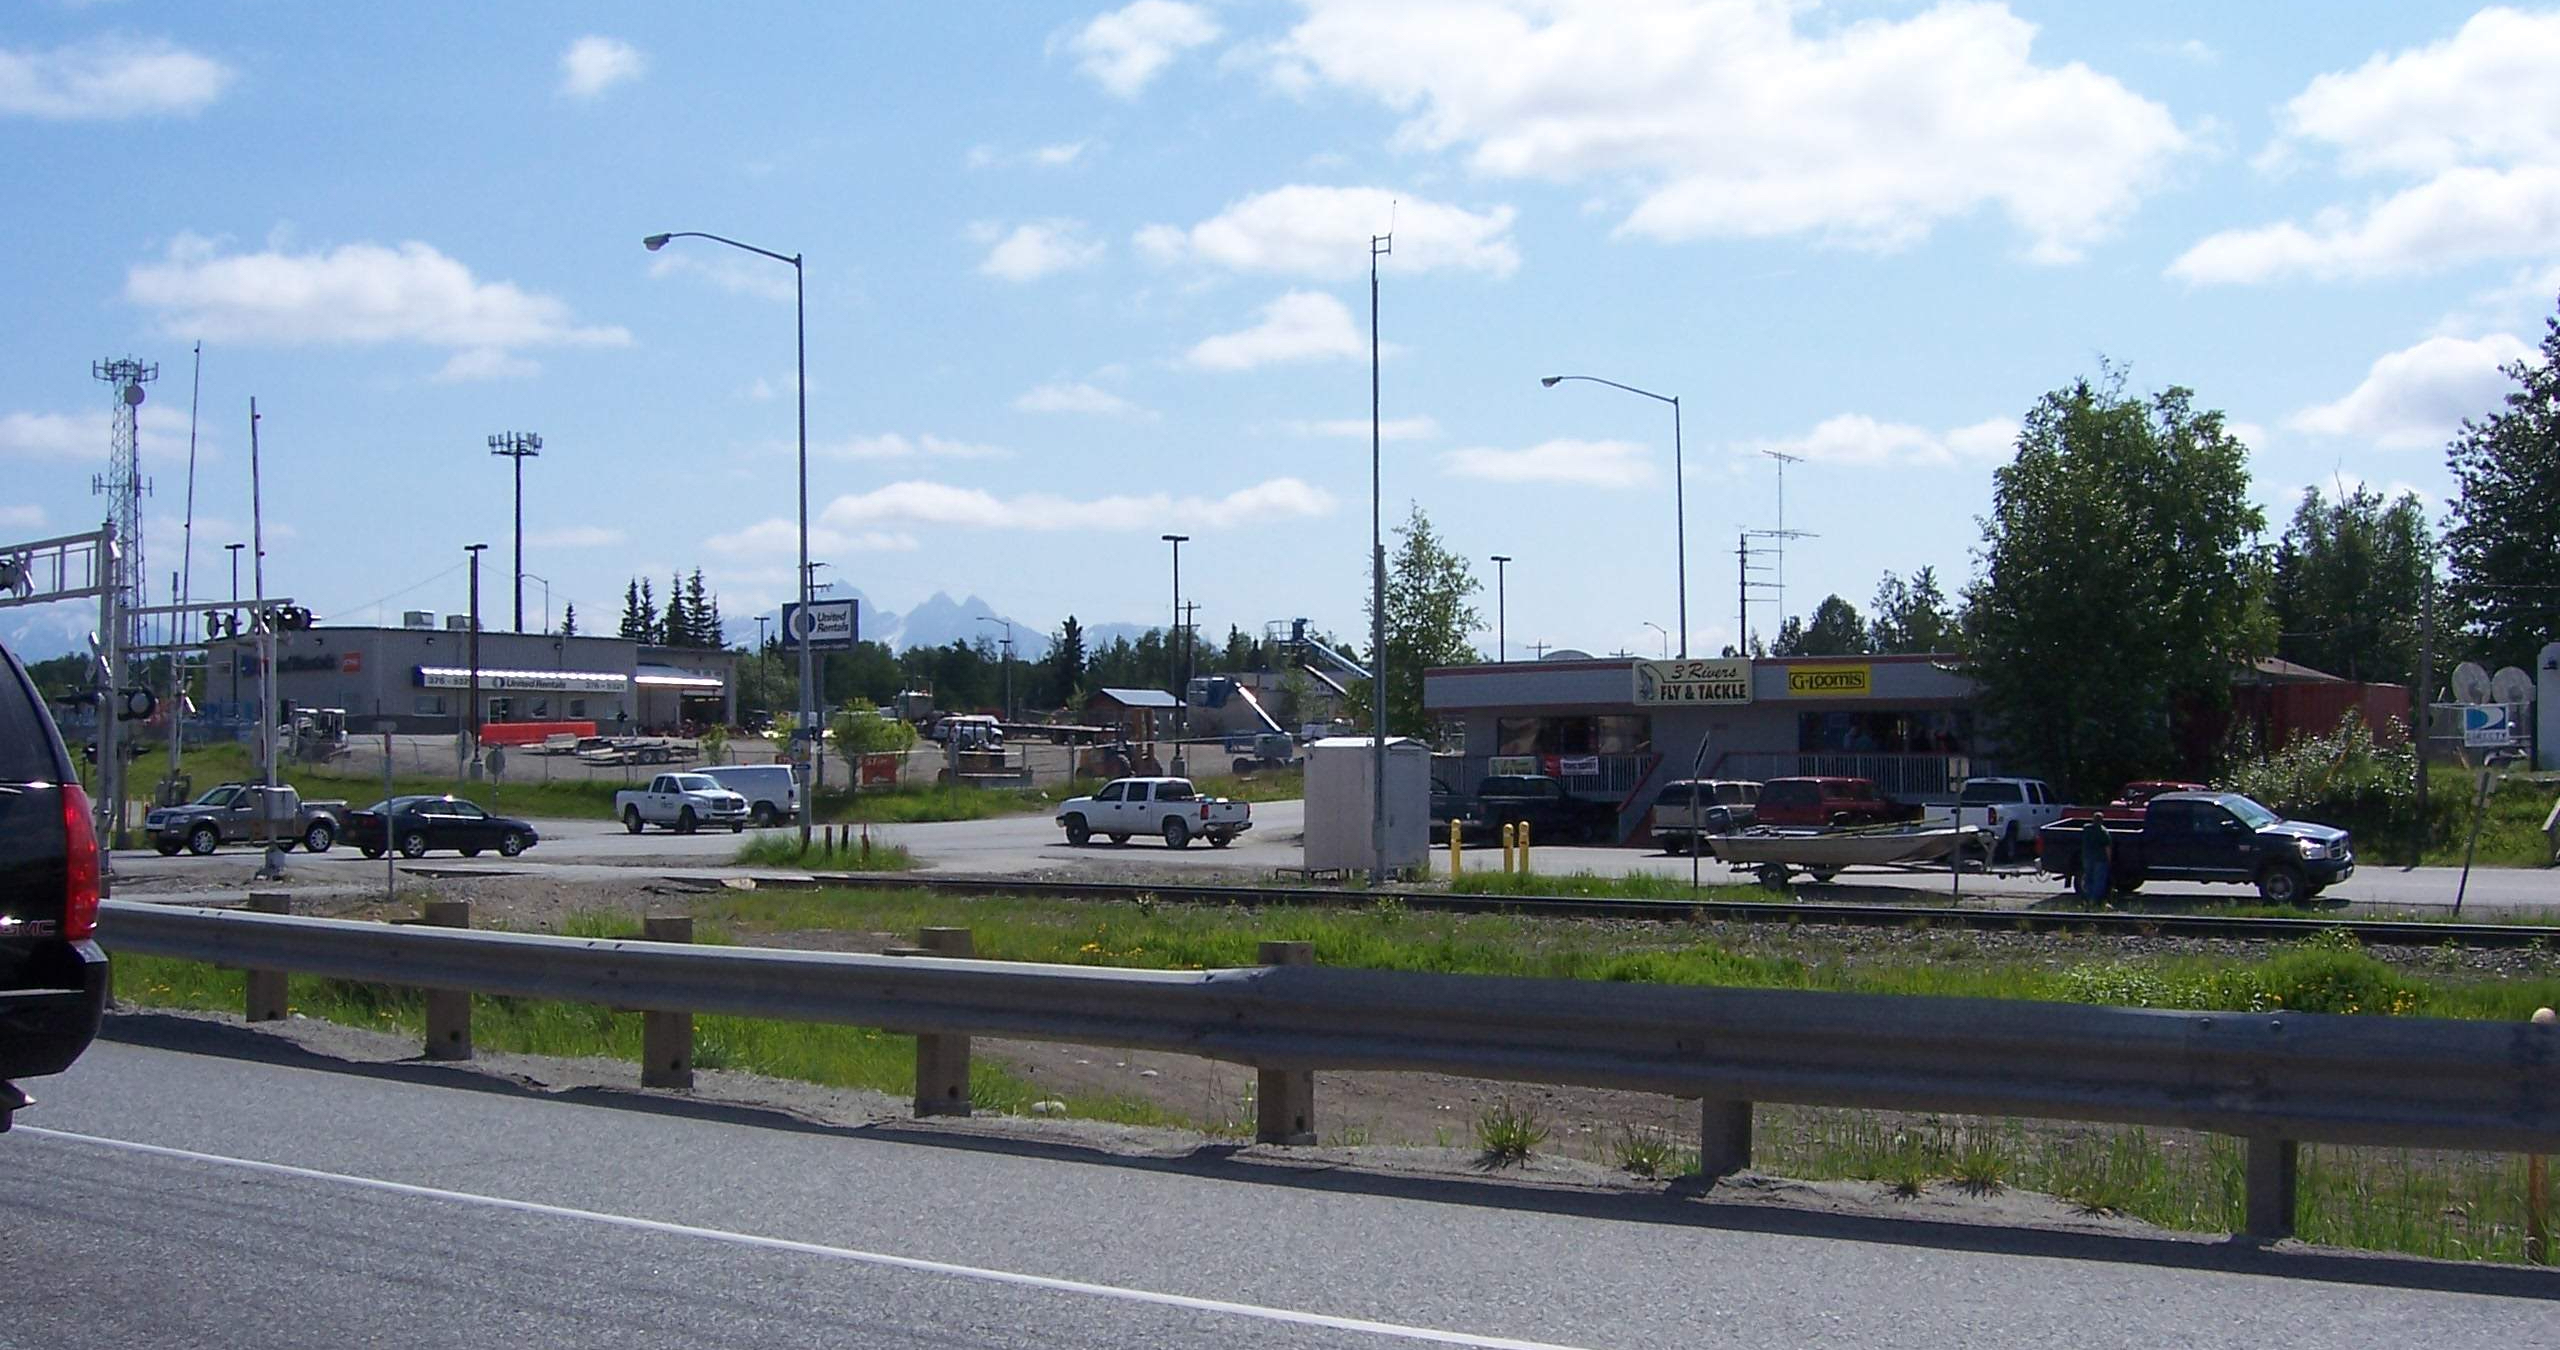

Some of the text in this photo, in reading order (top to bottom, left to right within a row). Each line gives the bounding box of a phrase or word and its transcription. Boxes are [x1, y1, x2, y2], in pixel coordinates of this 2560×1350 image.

[817, 610, 847, 622] United
[817, 622, 849, 632] Rentals
[1671, 662, 1737, 679] 3 Rivers
[506, 678, 566, 689] United Rentals
[1660, 684, 1746, 700] FLY & TACKLE
[0, 919, 56, 937] GMC
